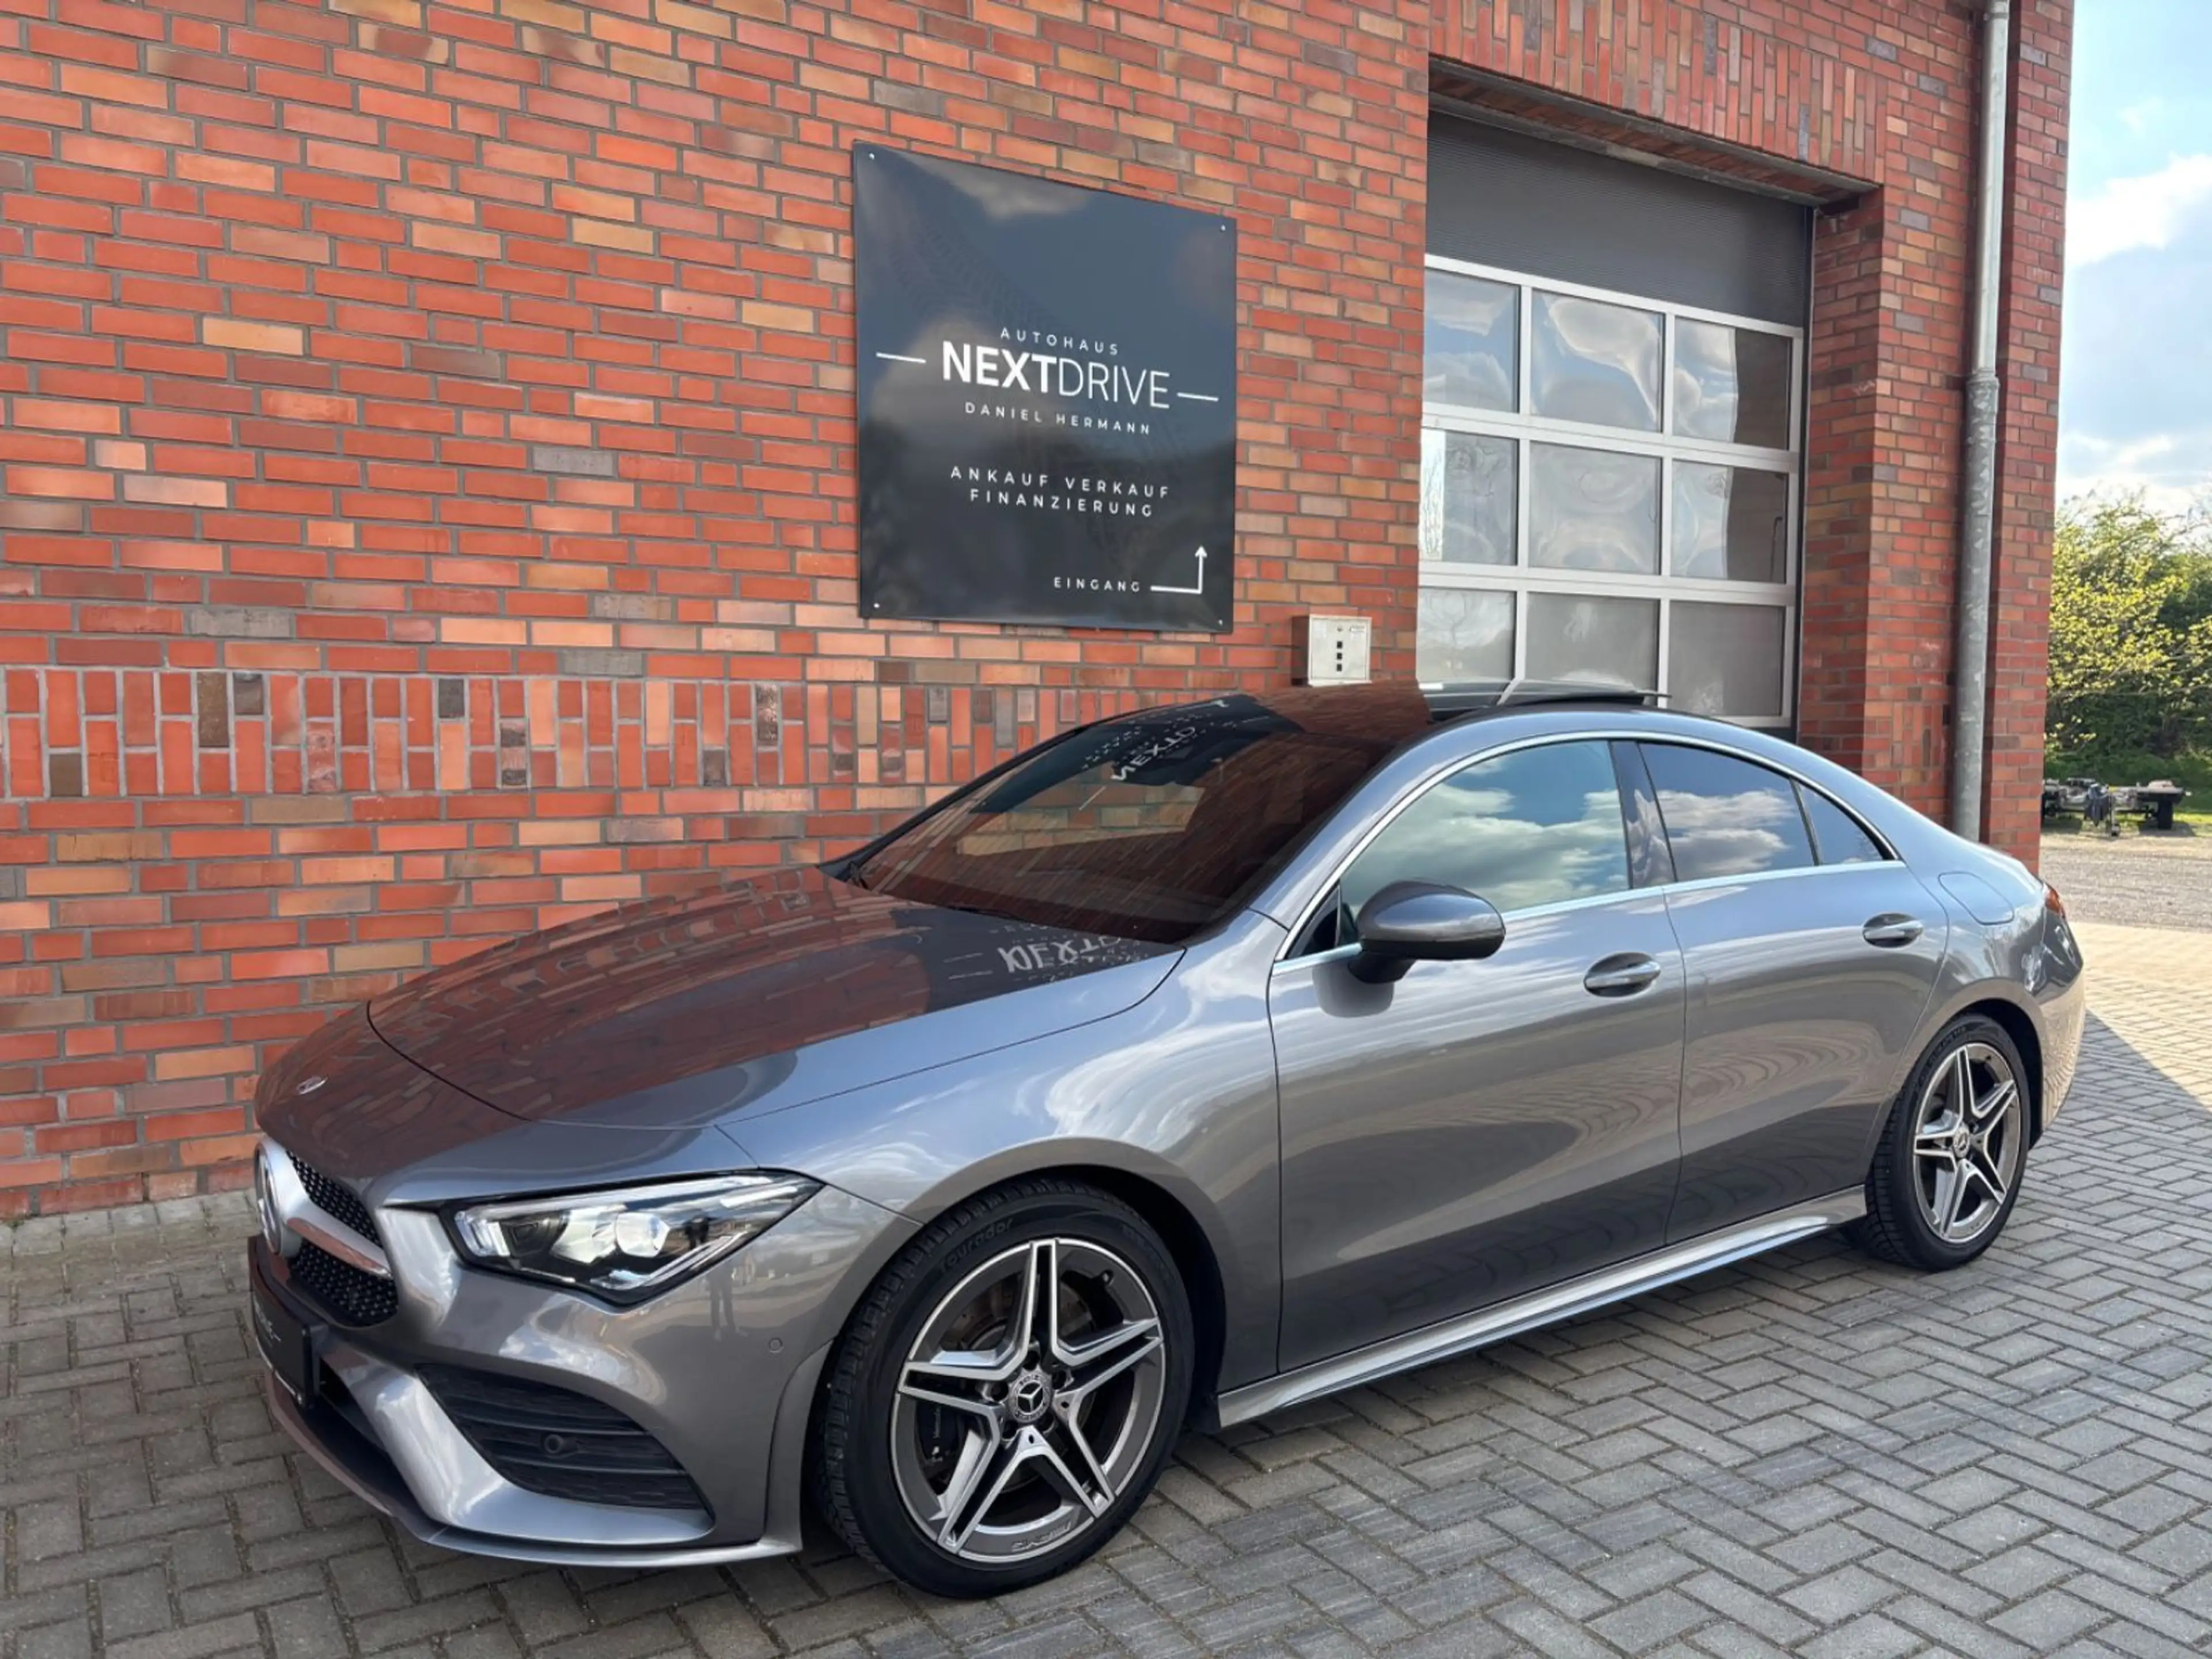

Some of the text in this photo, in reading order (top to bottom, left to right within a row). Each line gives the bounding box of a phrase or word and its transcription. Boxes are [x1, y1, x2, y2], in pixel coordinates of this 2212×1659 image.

[1000, 327, 1118, 356] AUTOHAUS
[942, 340, 1171, 410] NEXTDRIVE
[965, 402, 1150, 435] DANIEL HERMANN
[950, 465, 1169, 499] ANKAUF VERKAUF
[970, 488, 1152, 518] FINANZIERUNG
[1054, 577, 1140, 592] EINGANG
